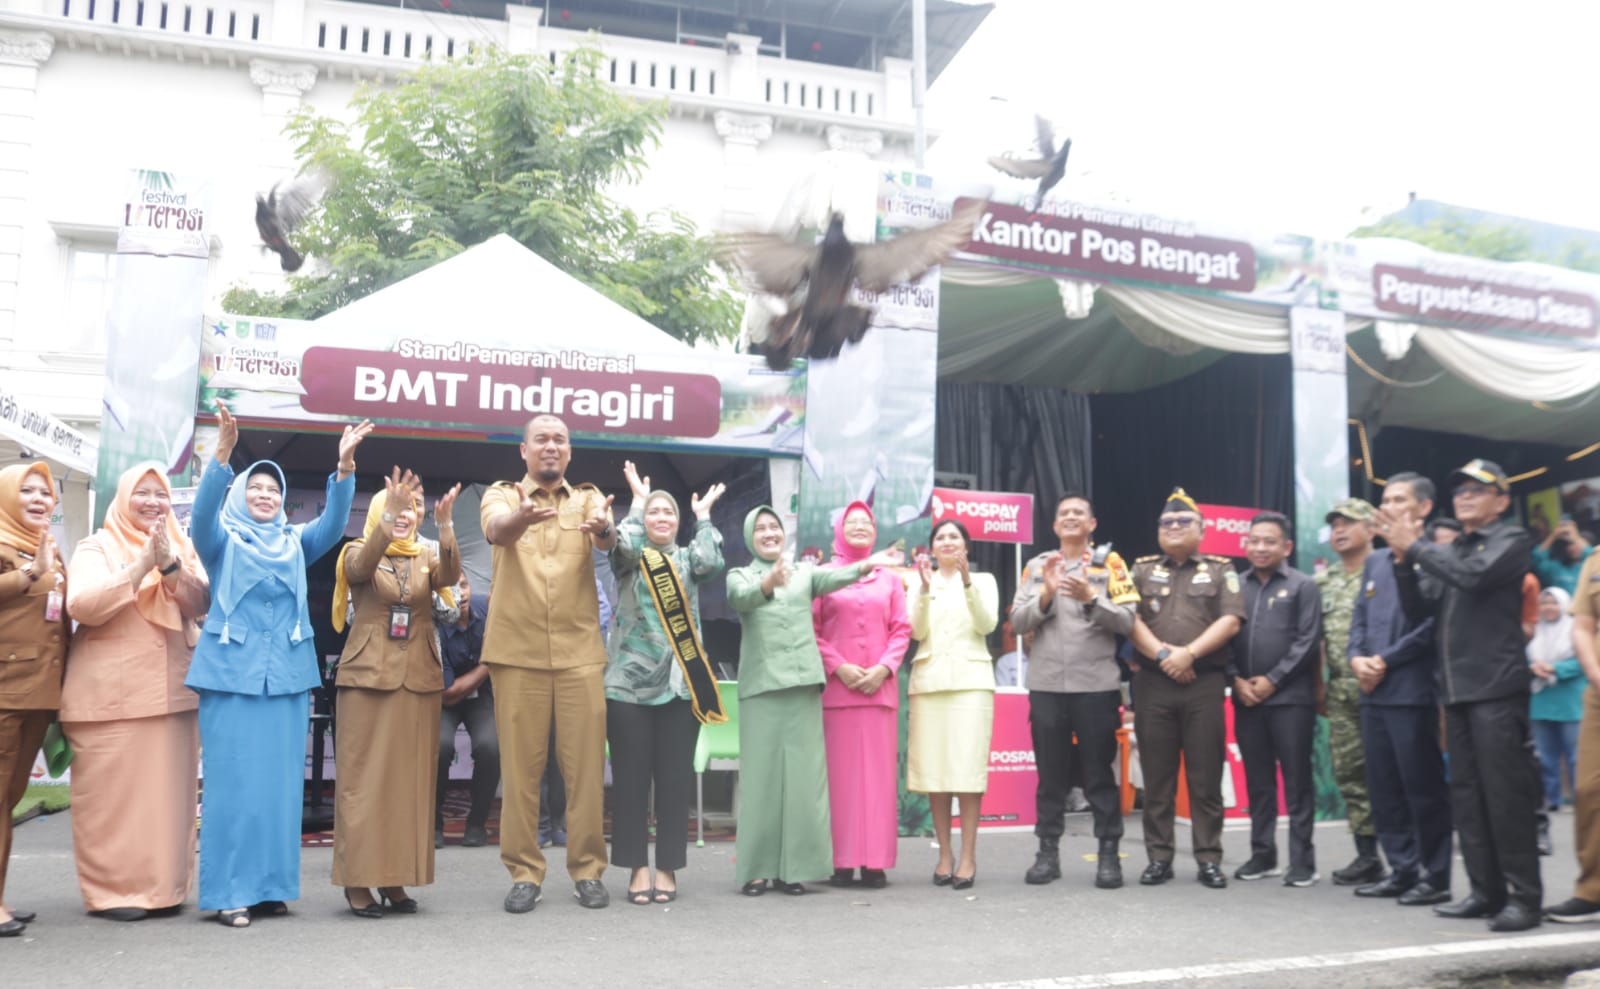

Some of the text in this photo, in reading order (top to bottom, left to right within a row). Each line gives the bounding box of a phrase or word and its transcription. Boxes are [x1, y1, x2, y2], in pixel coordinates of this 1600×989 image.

[142, 189, 187, 206] festival
[972, 212, 1241, 284] Kantor Pos Rengat
[1379, 273, 1537, 321] Perpustakaan
[231, 346, 279, 359] festival
[399, 338, 636, 374] Stand Pemeran Literasi
[353, 366, 675, 428] BMT Indragiri
[955, 500, 1020, 519] POSPAY
[983, 518, 1018, 535] point
[653, 571, 681, 613] LITERASI
